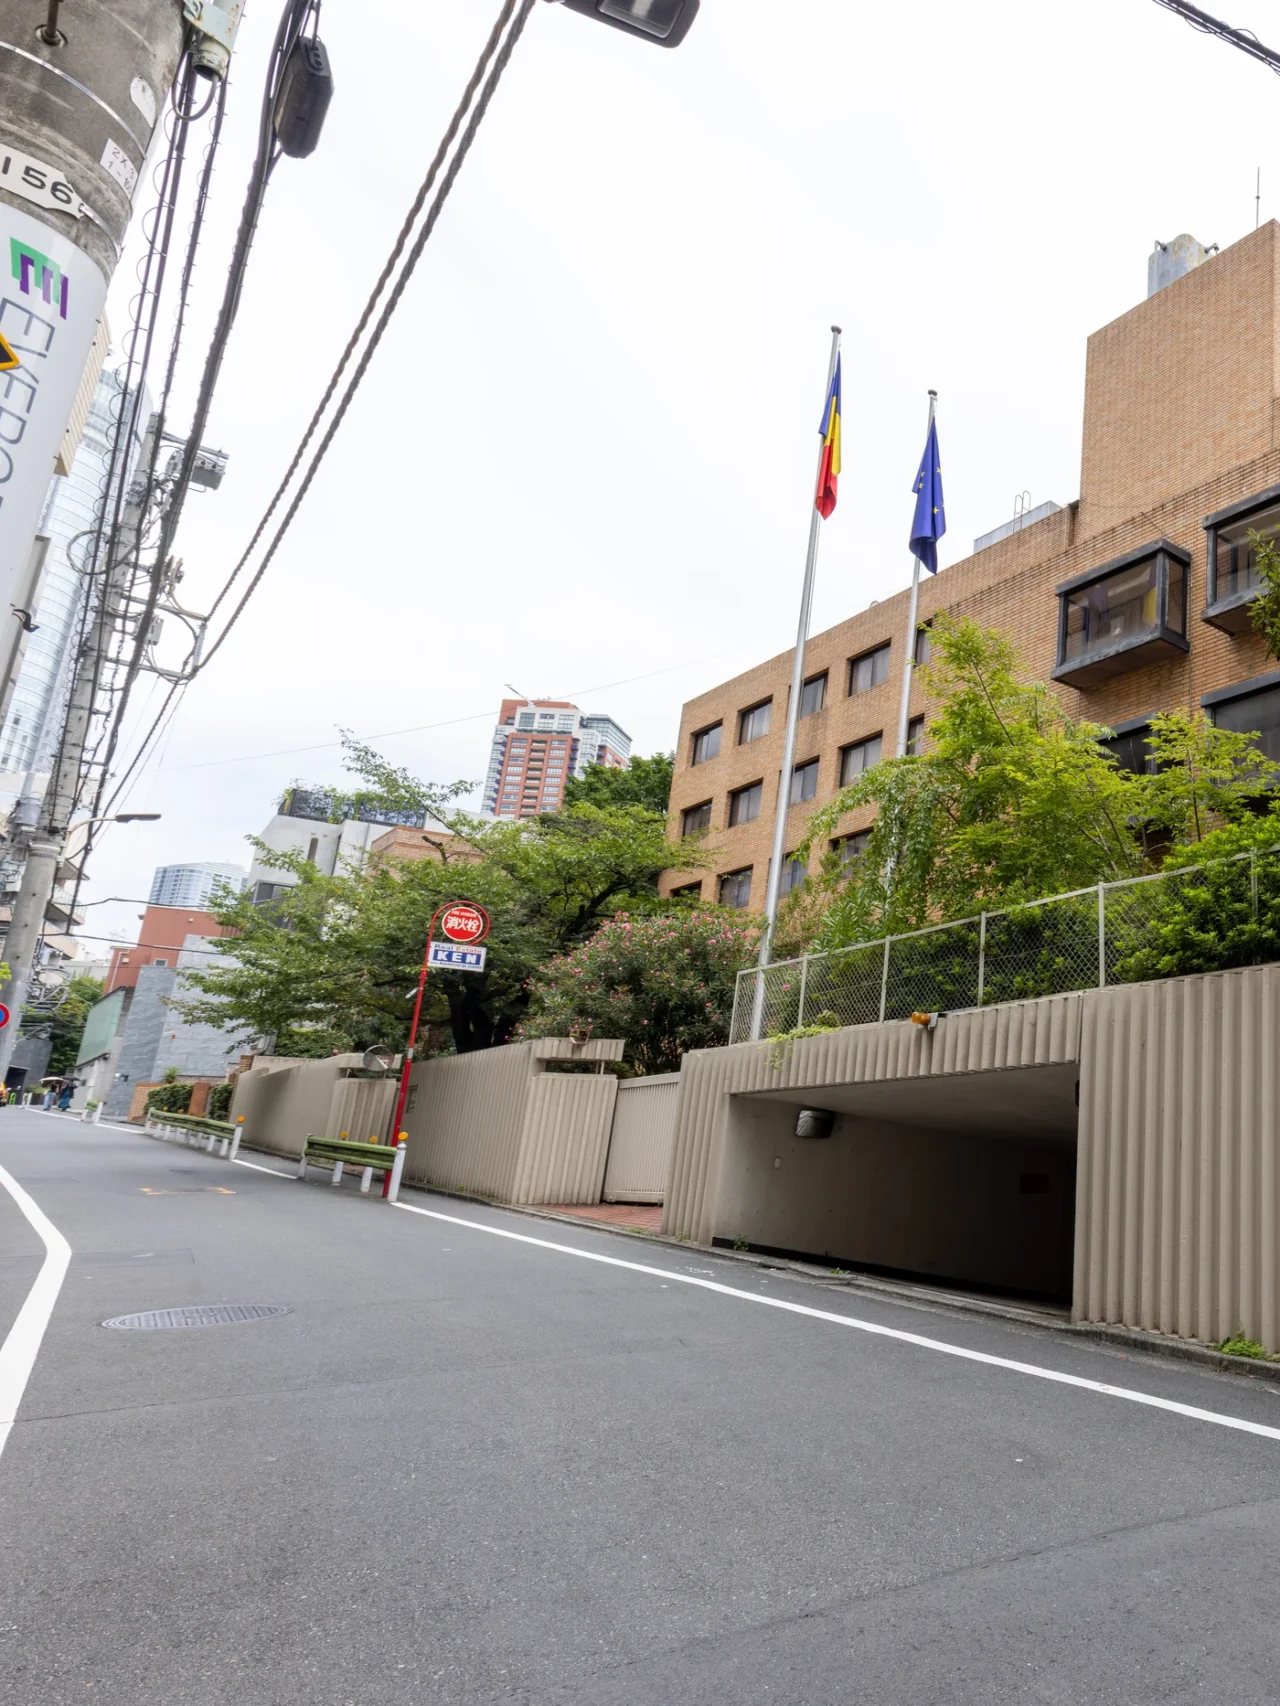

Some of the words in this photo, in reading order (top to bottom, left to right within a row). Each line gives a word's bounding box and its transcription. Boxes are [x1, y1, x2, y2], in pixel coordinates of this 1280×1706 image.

[2, 156, 73, 205] 156
[446, 916, 479, 932] 消火栓
[437, 950, 477, 964] KEN
